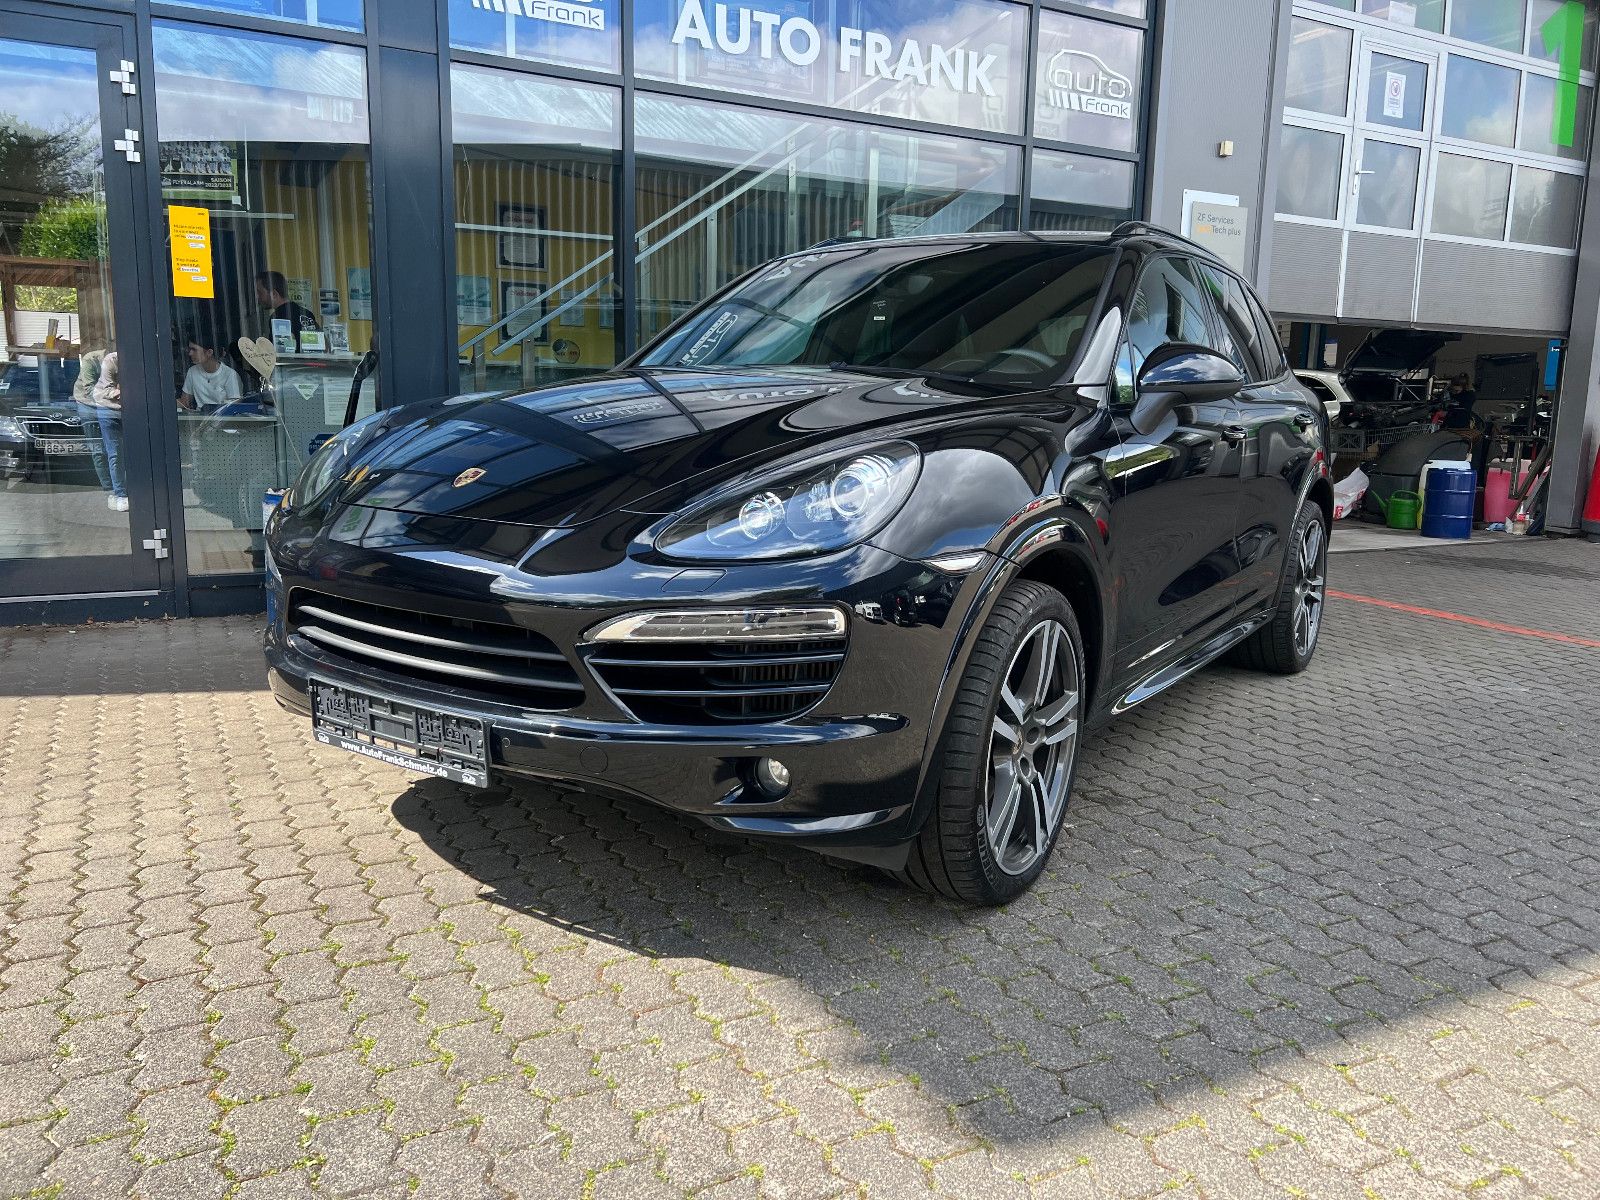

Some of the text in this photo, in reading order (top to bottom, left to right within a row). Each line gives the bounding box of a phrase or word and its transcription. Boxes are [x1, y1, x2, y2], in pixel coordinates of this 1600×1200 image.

[531, 1, 600, 27] Frank
[672, 0, 998, 97] AUTO FRANK
[1054, 69, 1126, 98] auto
[1539, 0, 1585, 147] 1
[1085, 98, 1129, 117] Frank
[1207, 214, 1234, 225] Services
